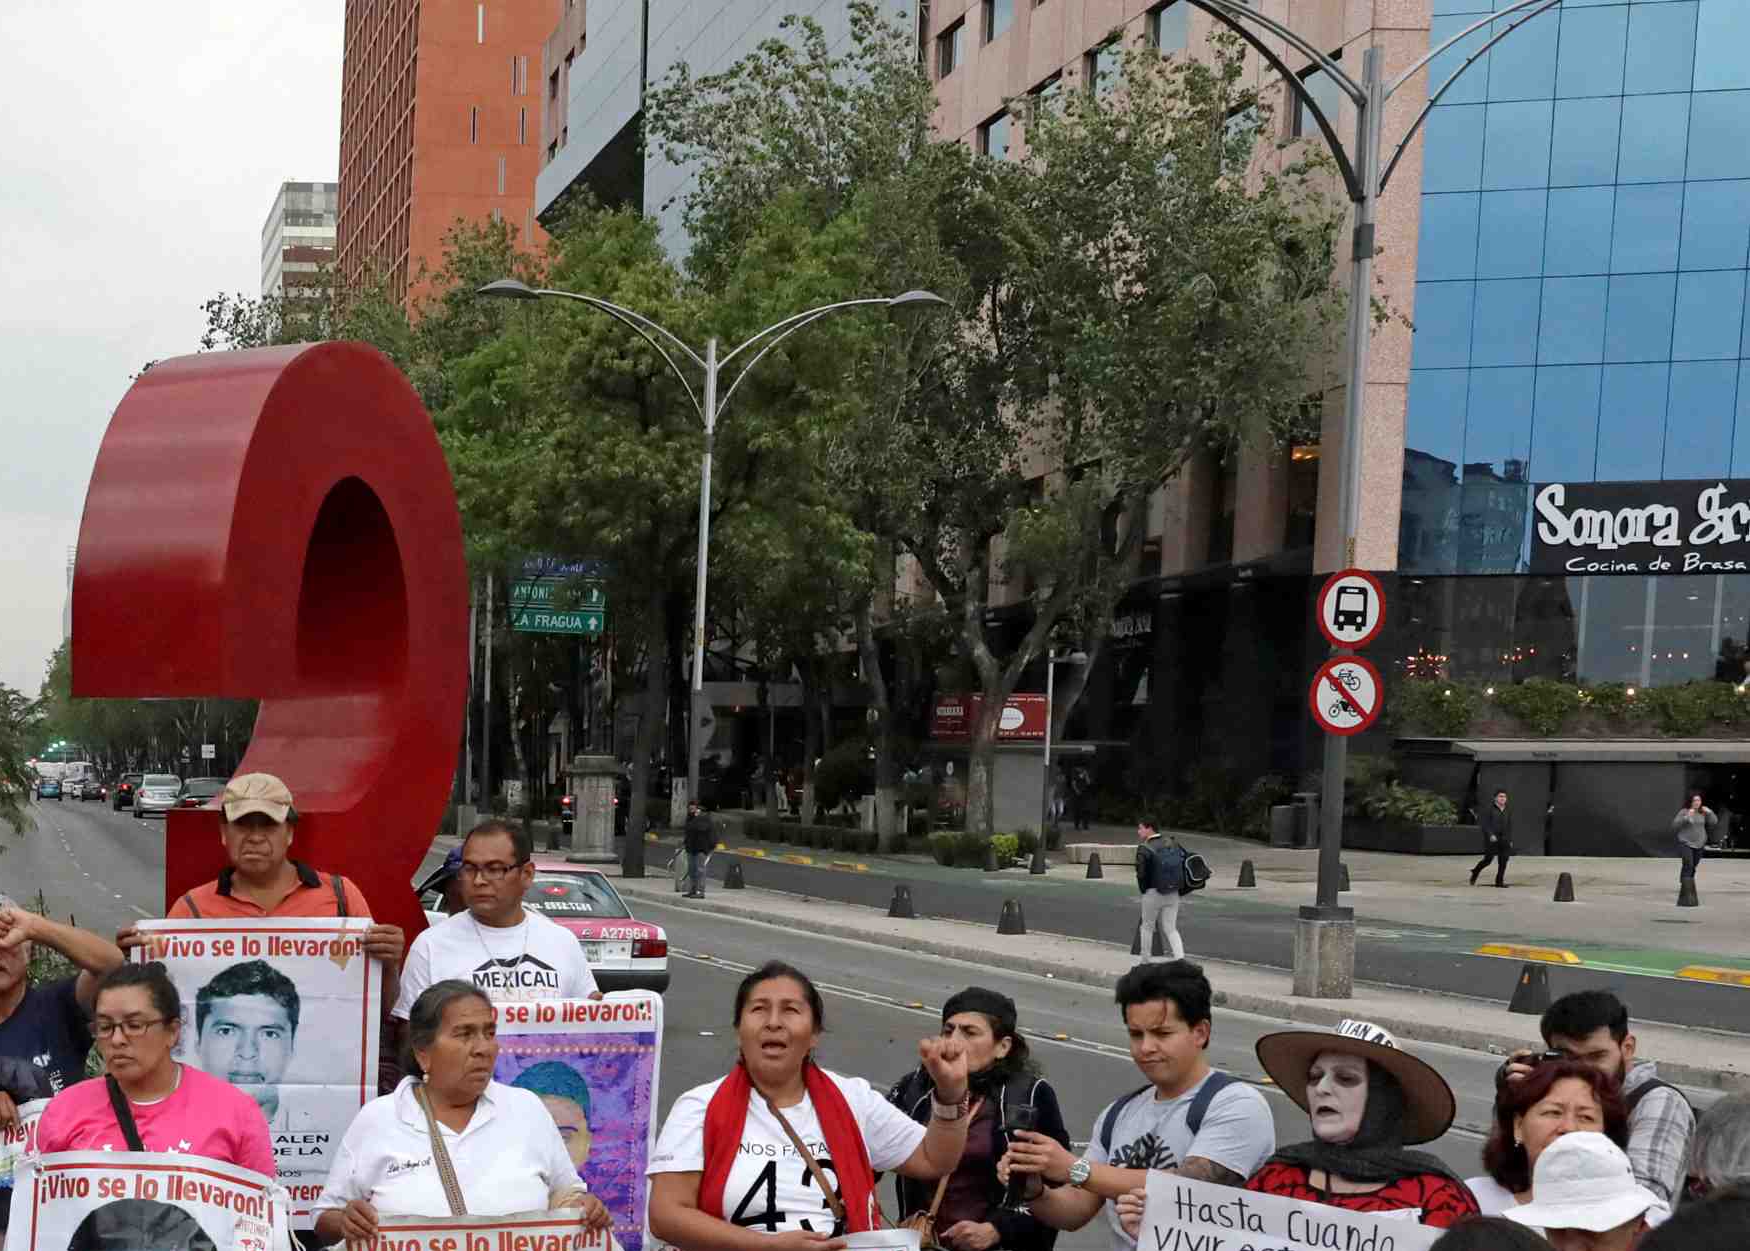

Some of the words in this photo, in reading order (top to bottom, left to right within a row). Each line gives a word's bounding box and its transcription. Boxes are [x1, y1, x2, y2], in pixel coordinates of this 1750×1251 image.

[1535, 484, 1682, 549] Sonora
[1689, 482, 1750, 545] gr
[1565, 556, 1638, 572] Cocina
[1649, 556, 1671, 570] de
[1682, 552, 1746, 572] Brasa
[534, 613, 582, 629] FRAGUA
[211, 938, 236, 957] se
[241, 936, 261, 957] lo
[267, 936, 361, 957] llevaron!
[472, 970, 559, 989] MEXICALI
[505, 1006, 529, 1024] se
[535, 1003, 556, 1024] lo
[298, 1146, 323, 1156] LA
[738, 1142, 777, 1157] NOS
[41, 1175, 90, 1204] ¡Vivo
[97, 1177, 126, 1199] se
[134, 1173, 159, 1201] lo
[167, 1175, 265, 1220] llevaron!
[1175, 1185, 1267, 1234] Hasta
